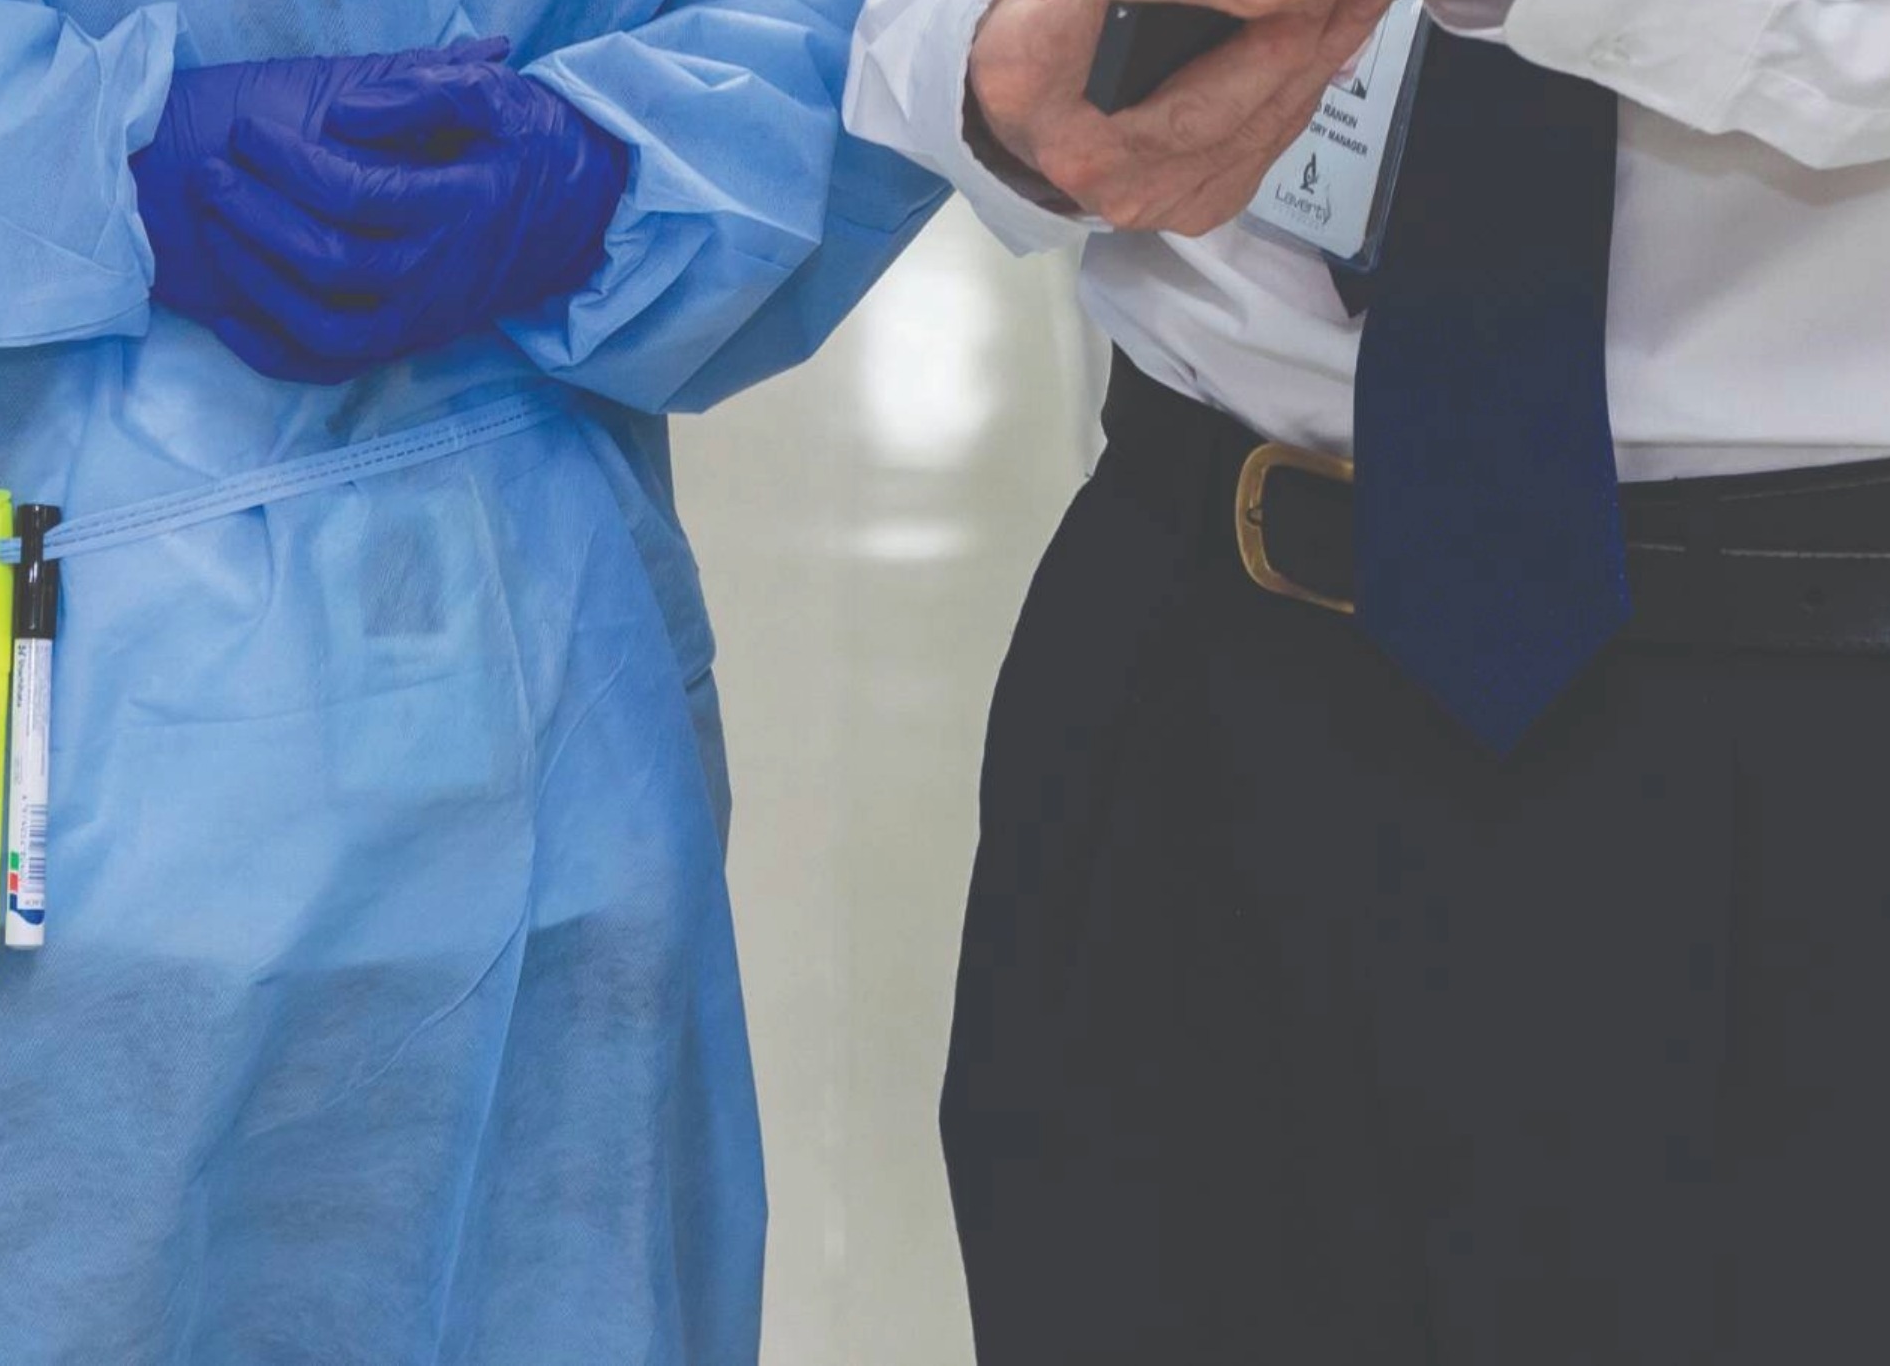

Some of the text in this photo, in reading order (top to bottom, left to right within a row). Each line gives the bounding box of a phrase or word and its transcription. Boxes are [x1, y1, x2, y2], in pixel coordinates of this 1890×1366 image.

[1322, 102, 1358, 129] RANKIN
[1326, 130, 1368, 156] MANAGER
[1274, 183, 1333, 225] Laverty
